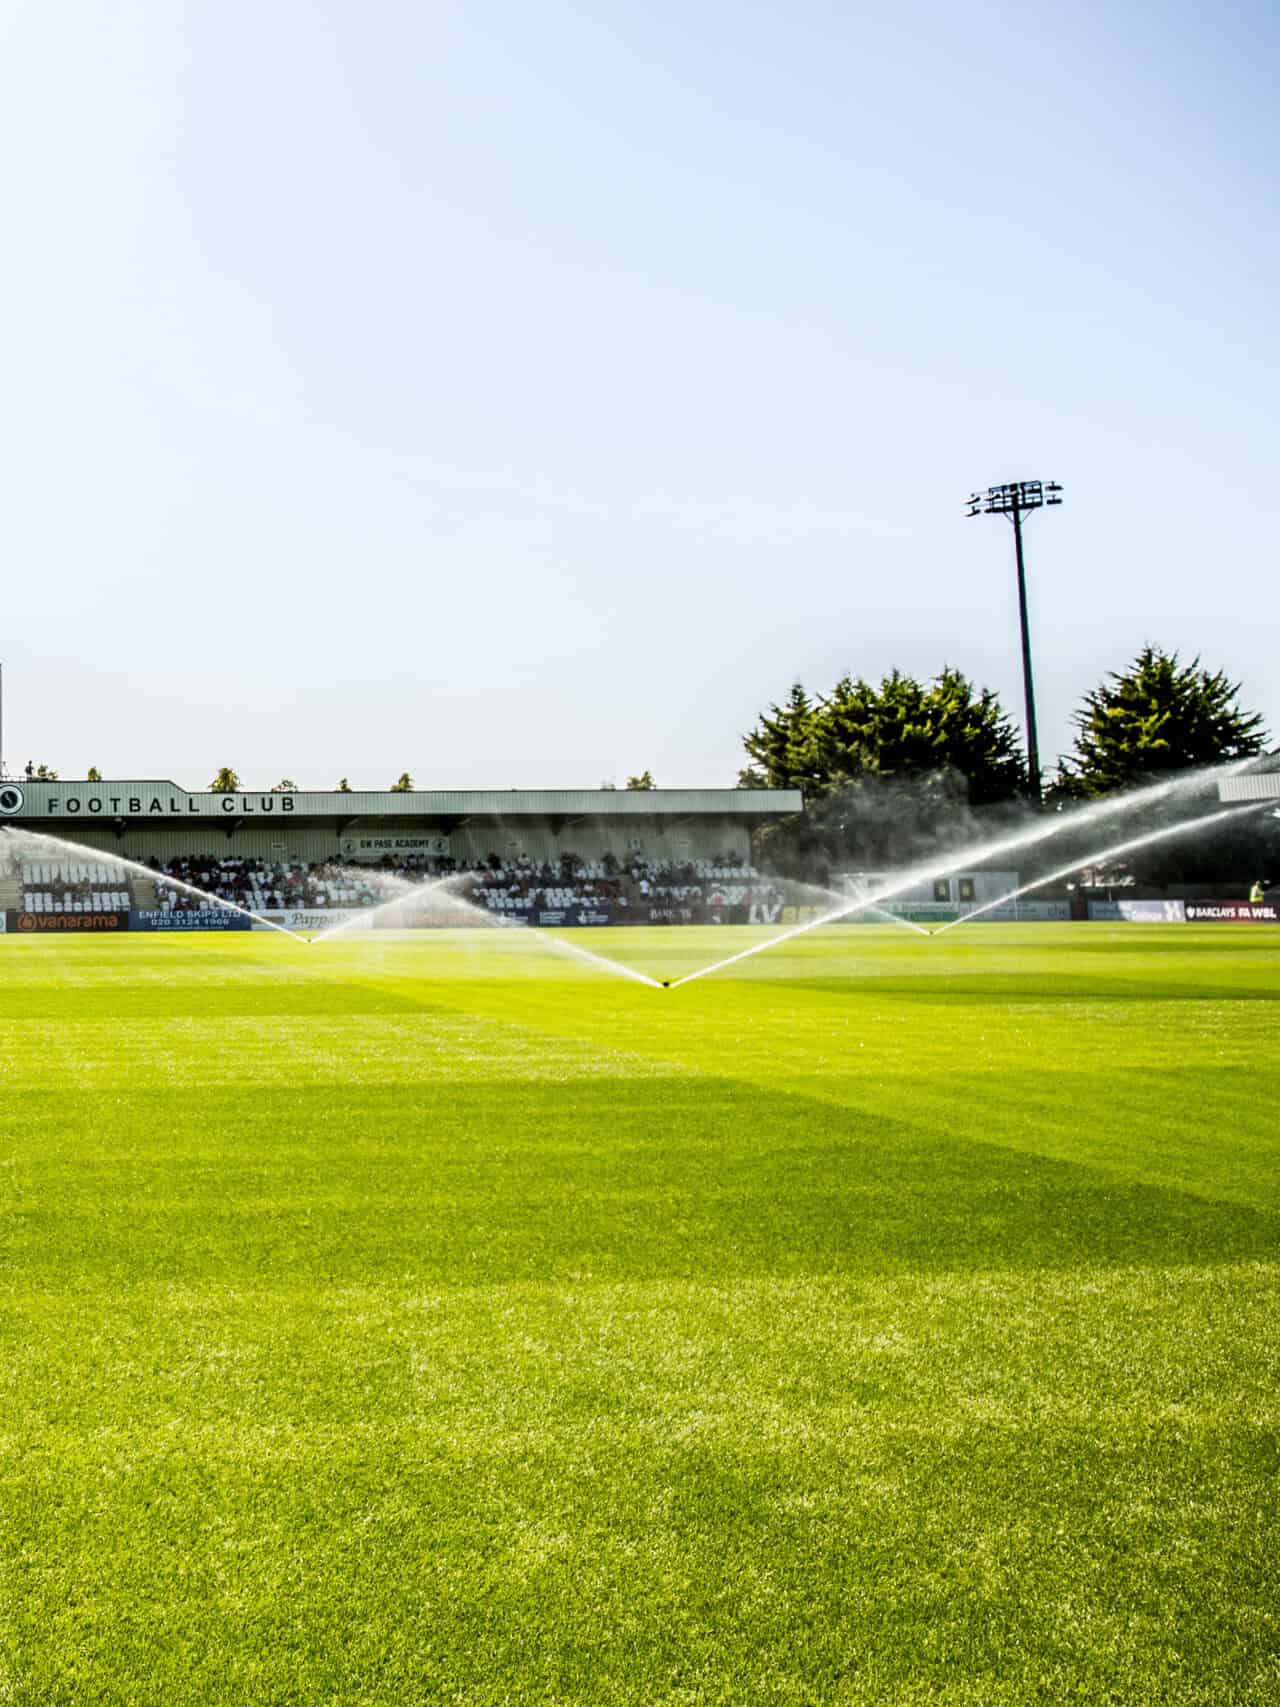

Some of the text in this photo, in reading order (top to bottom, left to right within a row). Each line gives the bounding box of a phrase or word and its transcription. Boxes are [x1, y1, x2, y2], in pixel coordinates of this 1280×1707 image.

[47, 797, 294, 814] FOOTBALL CLUB
[395, 839, 429, 849] ACADEMY
[138, 909, 241, 919] ENFIELD SKIPS LTD
[1195, 906, 1236, 919] BARCLAYS
[1237, 906, 1251, 919] FA
[38, 914, 118, 929] vanarama
[151, 918, 171, 926] 020
[175, 918, 200, 926] 3124
